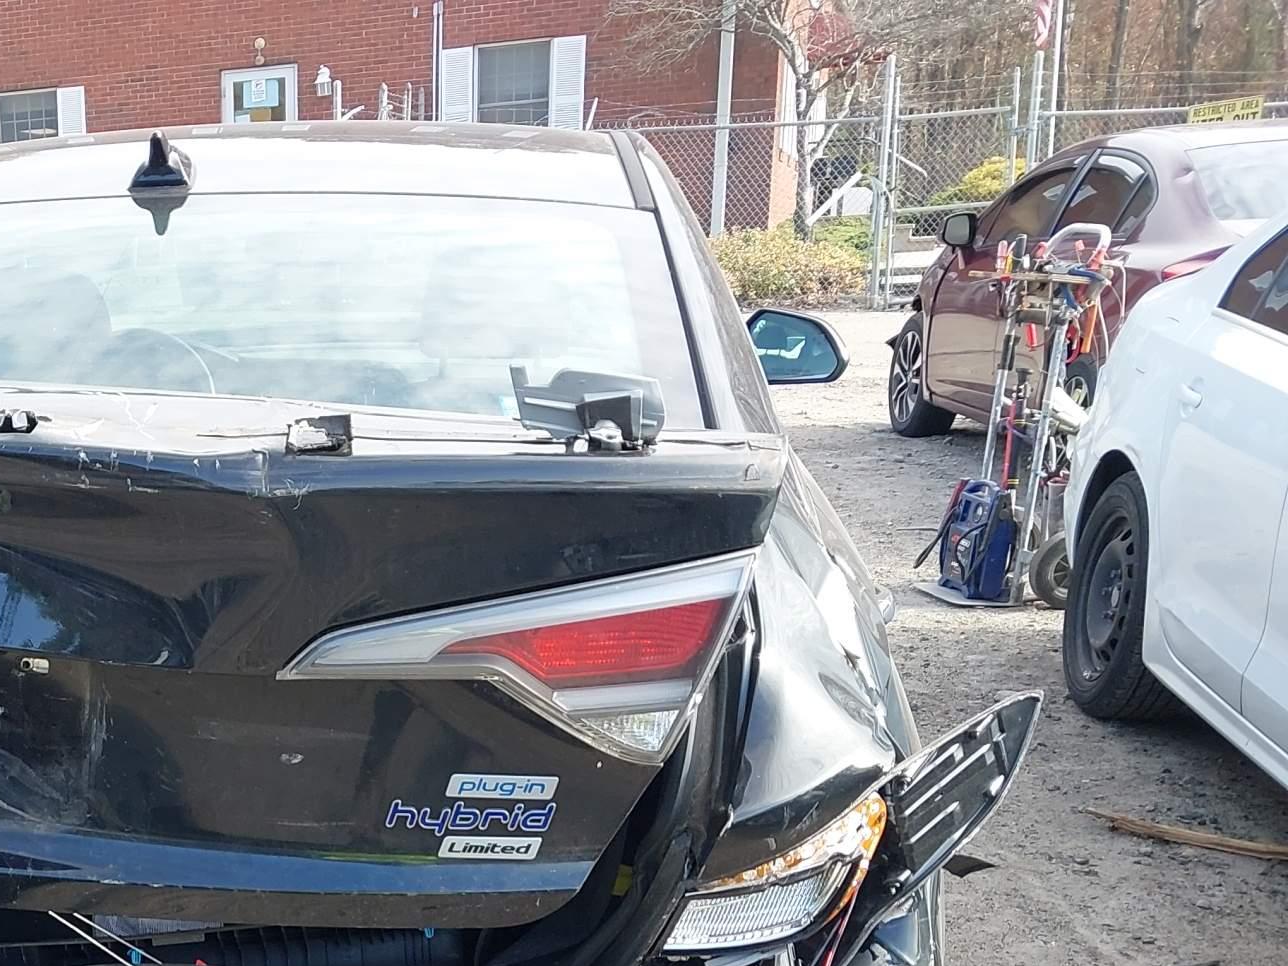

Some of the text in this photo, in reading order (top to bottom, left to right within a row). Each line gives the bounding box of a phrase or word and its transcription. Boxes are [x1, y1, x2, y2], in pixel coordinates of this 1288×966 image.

[1193, 99, 1259, 117] RESTRICTED AREA
[458, 778, 546, 796] plug-in
[385, 800, 557, 836] hybrid
[447, 841, 533, 855] Limited
